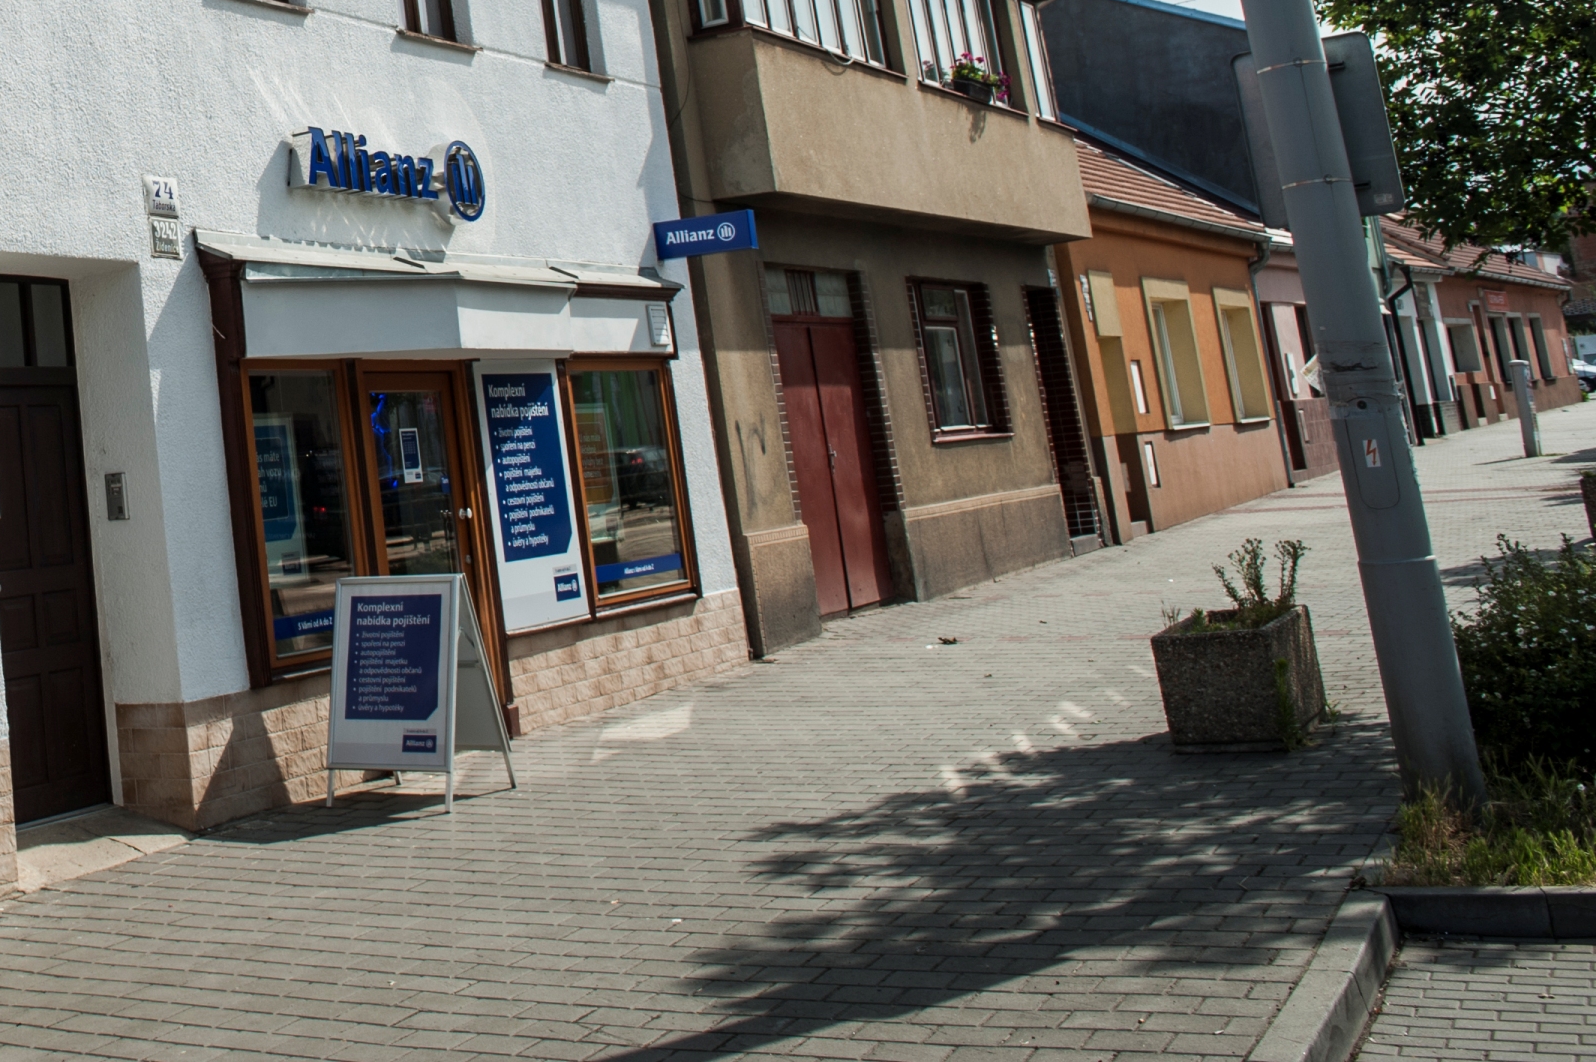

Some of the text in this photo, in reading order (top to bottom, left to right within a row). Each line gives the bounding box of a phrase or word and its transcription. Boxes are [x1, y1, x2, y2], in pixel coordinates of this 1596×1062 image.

[308, 126, 439, 200] Allianz
[152, 180, 173, 199] 74
[153, 221, 177, 239] 3242
[666, 229, 715, 245] Allianz
[488, 383, 525, 401] Komplexní
[491, 402, 549, 420] nabídka pojištění
[269, 496, 278, 506] EU
[557, 582, 572, 592] Allianz
[357, 601, 404, 614] Komplexní
[357, 615, 430, 627] nabídka pojištění
[362, 630, 404, 639] životní pojištění
[361, 640, 381, 648] spoření
[360, 649, 396, 657] autopojištění
[359, 657, 408, 666] pojištění majetku
[363, 667, 401, 675] odpovědnosti
[382, 676, 405, 685] pojištění
[384, 685, 417, 694] podnikatelů
[362, 695, 389, 703] průmyslu
[358, 704, 374, 712] úvěry
[378, 704, 404, 712] hypotéky
